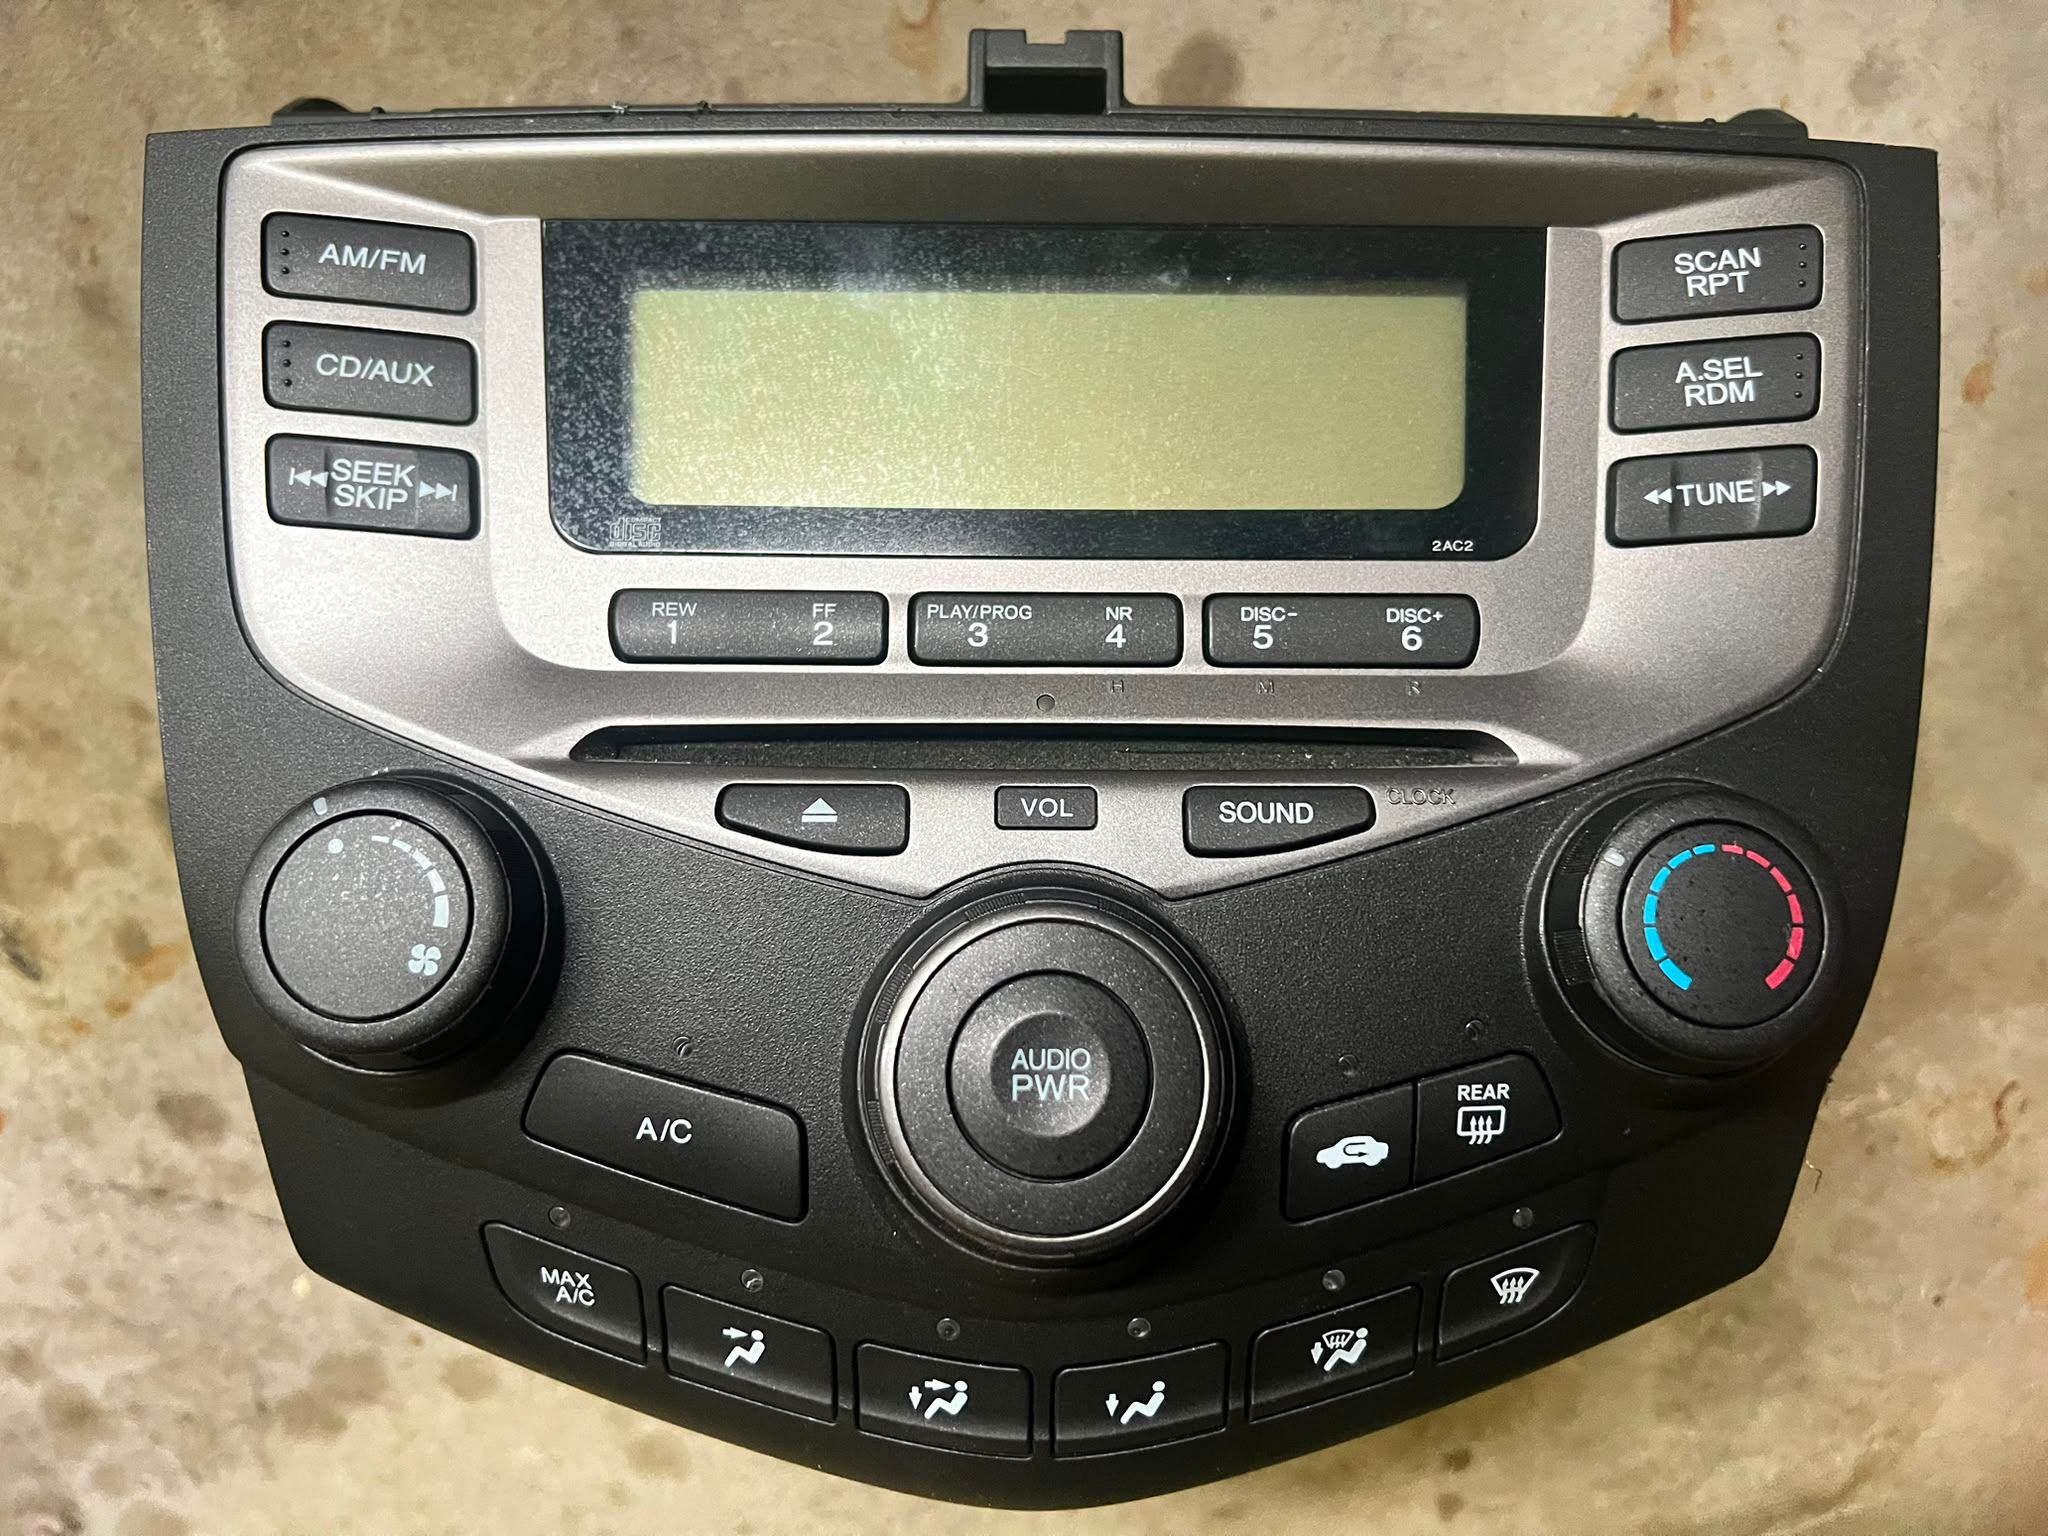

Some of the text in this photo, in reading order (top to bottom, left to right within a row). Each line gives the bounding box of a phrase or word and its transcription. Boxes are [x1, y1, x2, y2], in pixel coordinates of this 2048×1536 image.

[318, 243, 427, 275] AM/FM
[1674, 247, 1761, 276] SCAN
[1687, 270, 1749, 297] RPT
[315, 353, 434, 387] CD/AUX
[1675, 356, 1763, 384] A.SEL
[1684, 381, 1755, 407] RDM
[330, 458, 415, 487] SEEK
[333, 484, 408, 510] SKIP
[1676, 480, 1756, 506] TUNE
[1432, 540, 1474, 552] 2AC2
[651, 602, 697, 616] REW
[812, 604, 837, 618] FF
[927, 605, 1032, 620] PLAY/PROG
[1105, 607, 1132, 621] NR
[1240, 607, 1298, 622] DISC-
[1386, 608, 1443, 624] DISC+
[667, 621, 678, 645] 1
[813, 622, 833, 646] 2
[967, 624, 989, 647] 3
[1105, 625, 1126, 648] 4
[1252, 626, 1273, 649] 5
[1401, 627, 1422, 651] 6
[1110, 680, 1125, 693] H
[1256, 681, 1275, 694] M
[1021, 798, 1073, 817] VOL
[1386, 787, 1455, 806] CLOCK
[1219, 801, 1314, 824] SOUND
[1011, 1048, 1091, 1070] AUDIO
[1011, 1074, 1091, 1101] PWR
[1457, 1084, 1510, 1101] REAR
[636, 1117, 693, 1144] A/C
[540, 1266, 592, 1289] MAX
[555, 1286, 595, 1307] A/C
